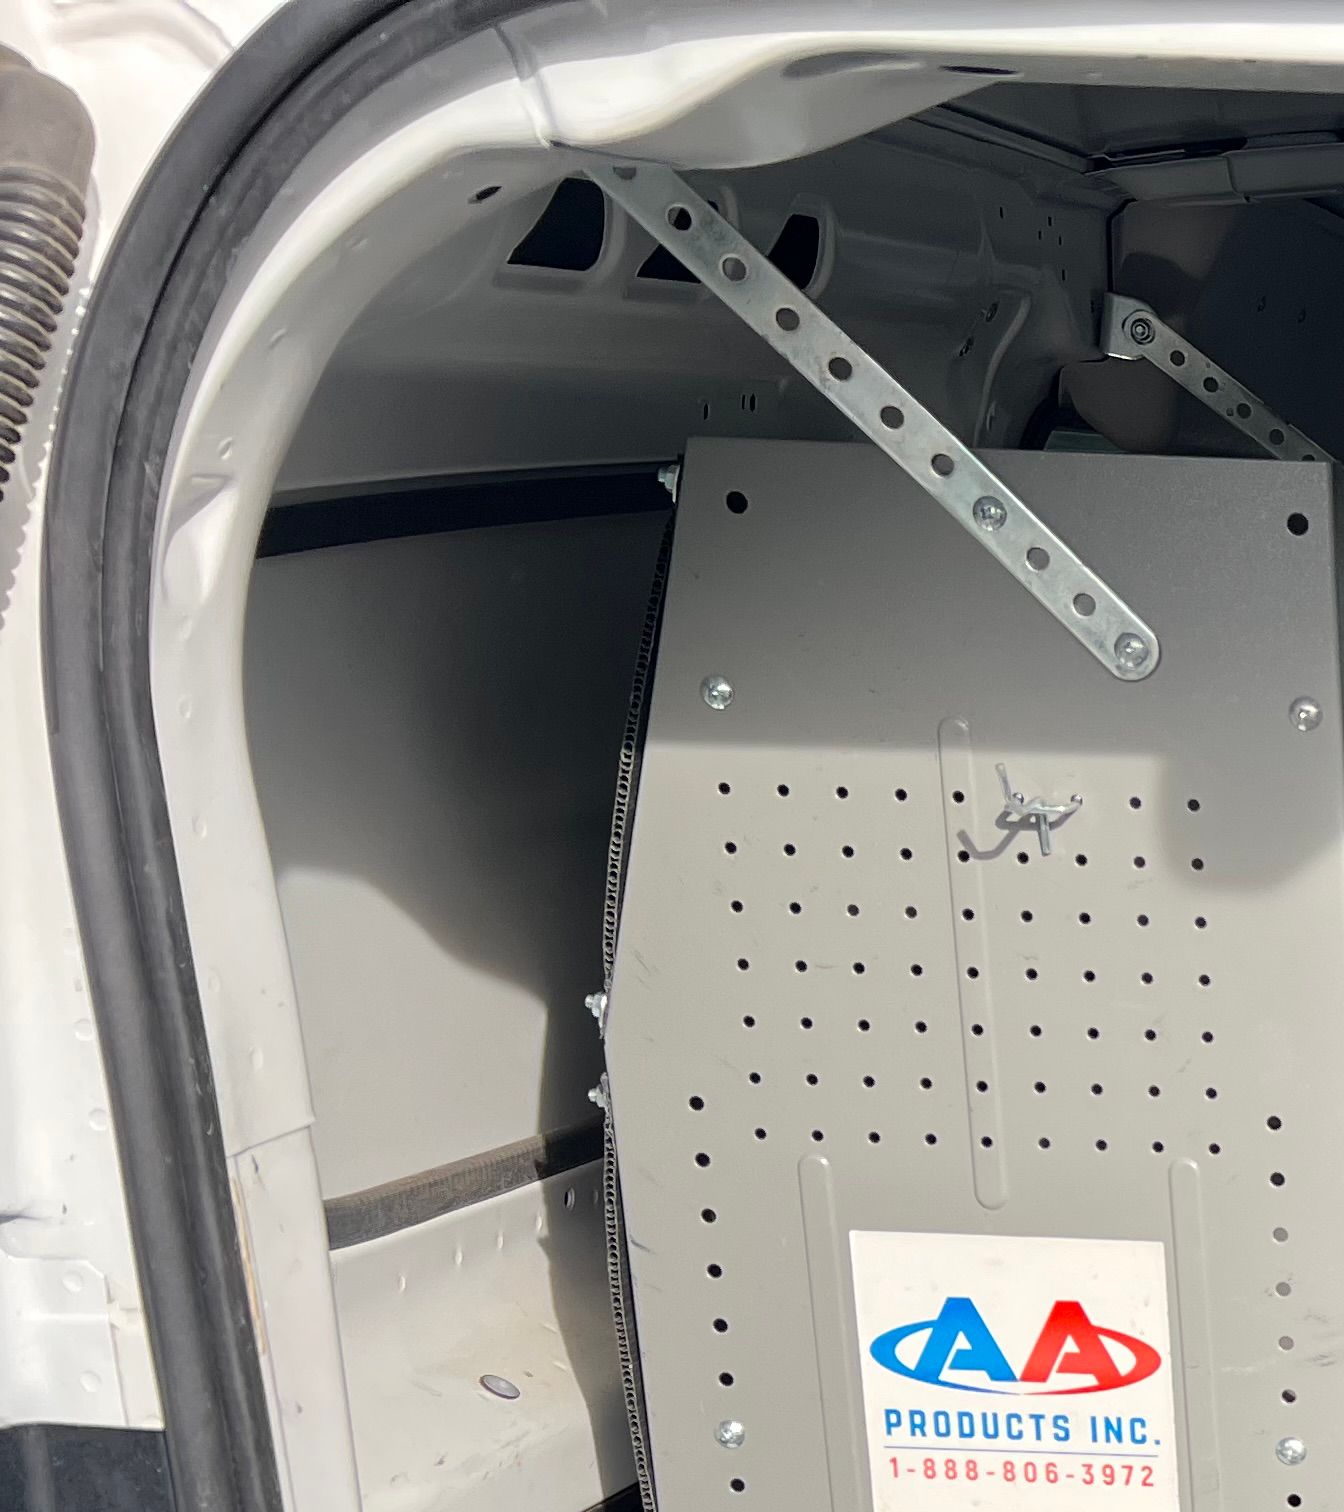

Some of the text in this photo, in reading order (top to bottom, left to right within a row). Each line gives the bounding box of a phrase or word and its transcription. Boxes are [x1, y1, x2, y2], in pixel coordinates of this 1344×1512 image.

[869, 1296, 1162, 1396] AA
[884, 1408, 1161, 1446] PRODUCTS INC.
[889, 1457, 1155, 1487] 1-888-806-3972
